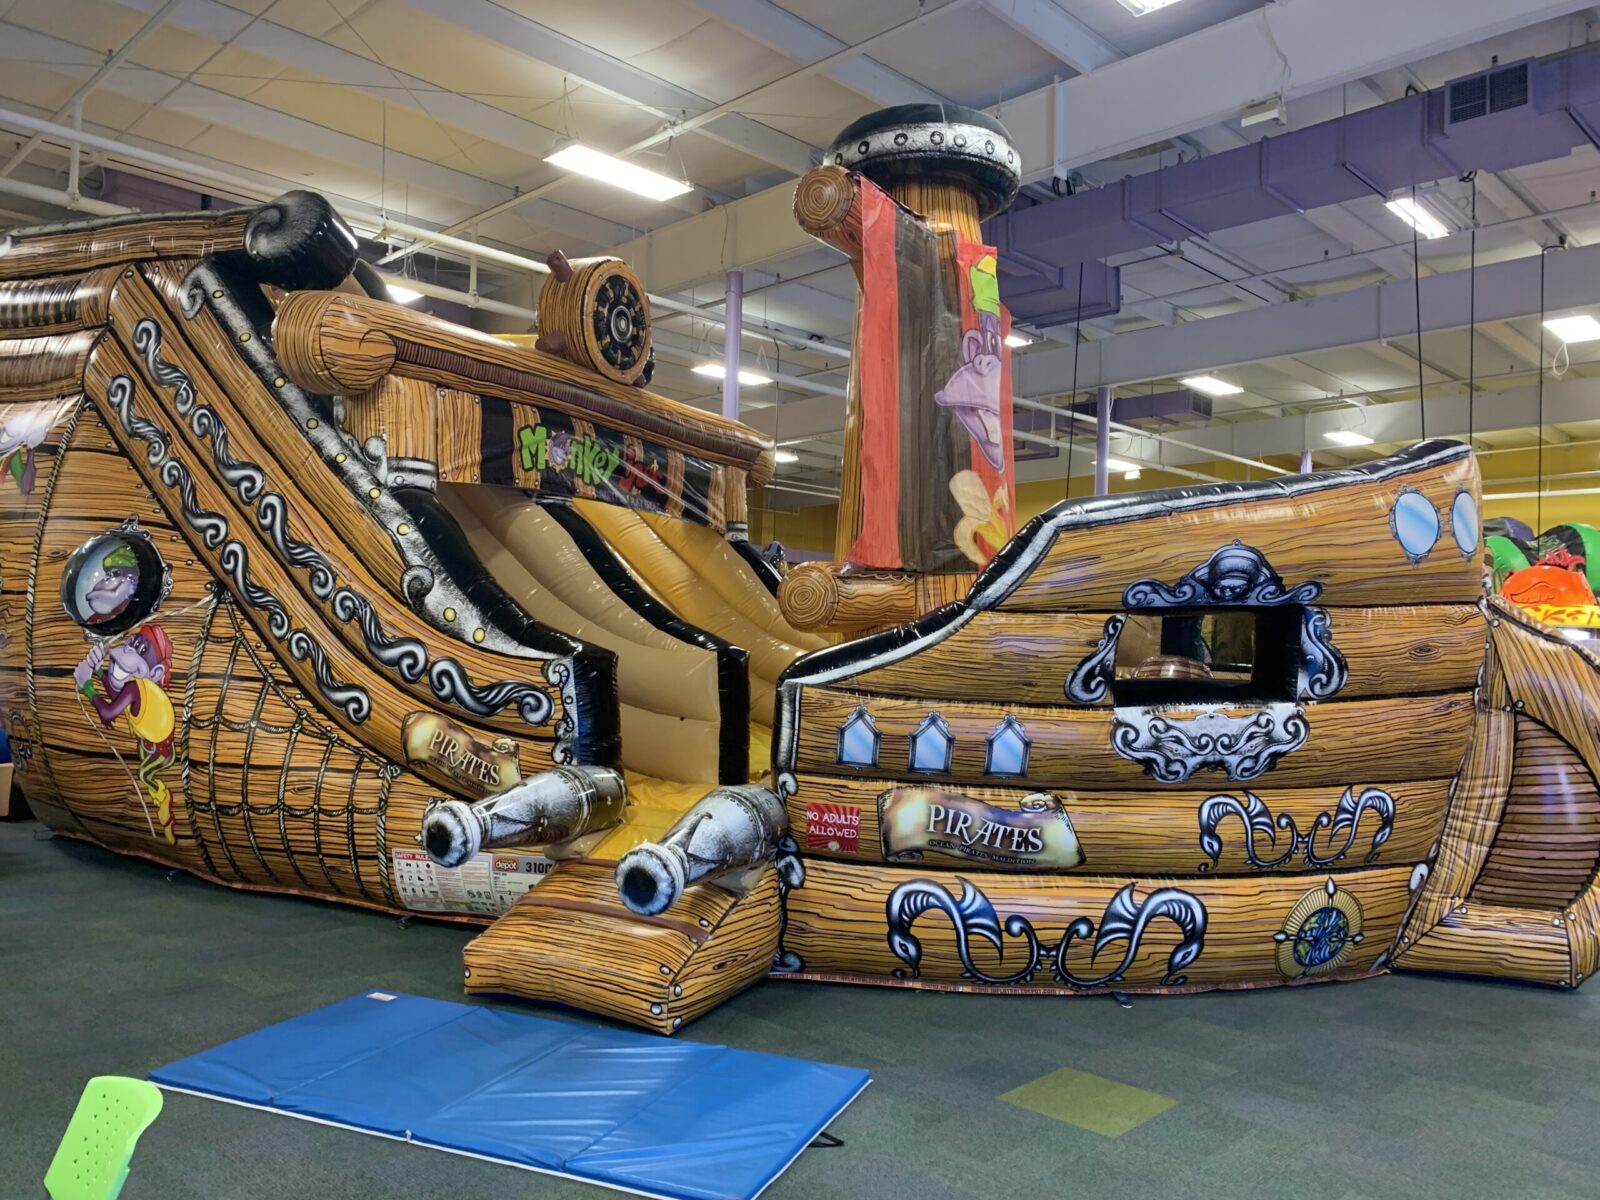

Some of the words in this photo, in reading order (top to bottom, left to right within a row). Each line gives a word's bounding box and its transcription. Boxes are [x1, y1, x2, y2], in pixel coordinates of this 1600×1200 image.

[429, 729, 500, 785] PIRATES
[806, 811, 819, 821] NO
[822, 813, 859, 826] ADULTS
[809, 825, 859, 839] ALLOWED.
[927, 804, 1044, 852] PIRATES
[928, 839, 956, 849] OCEAN
[960, 845, 988, 858] PIRATES
[495, 861, 517, 871] depot
